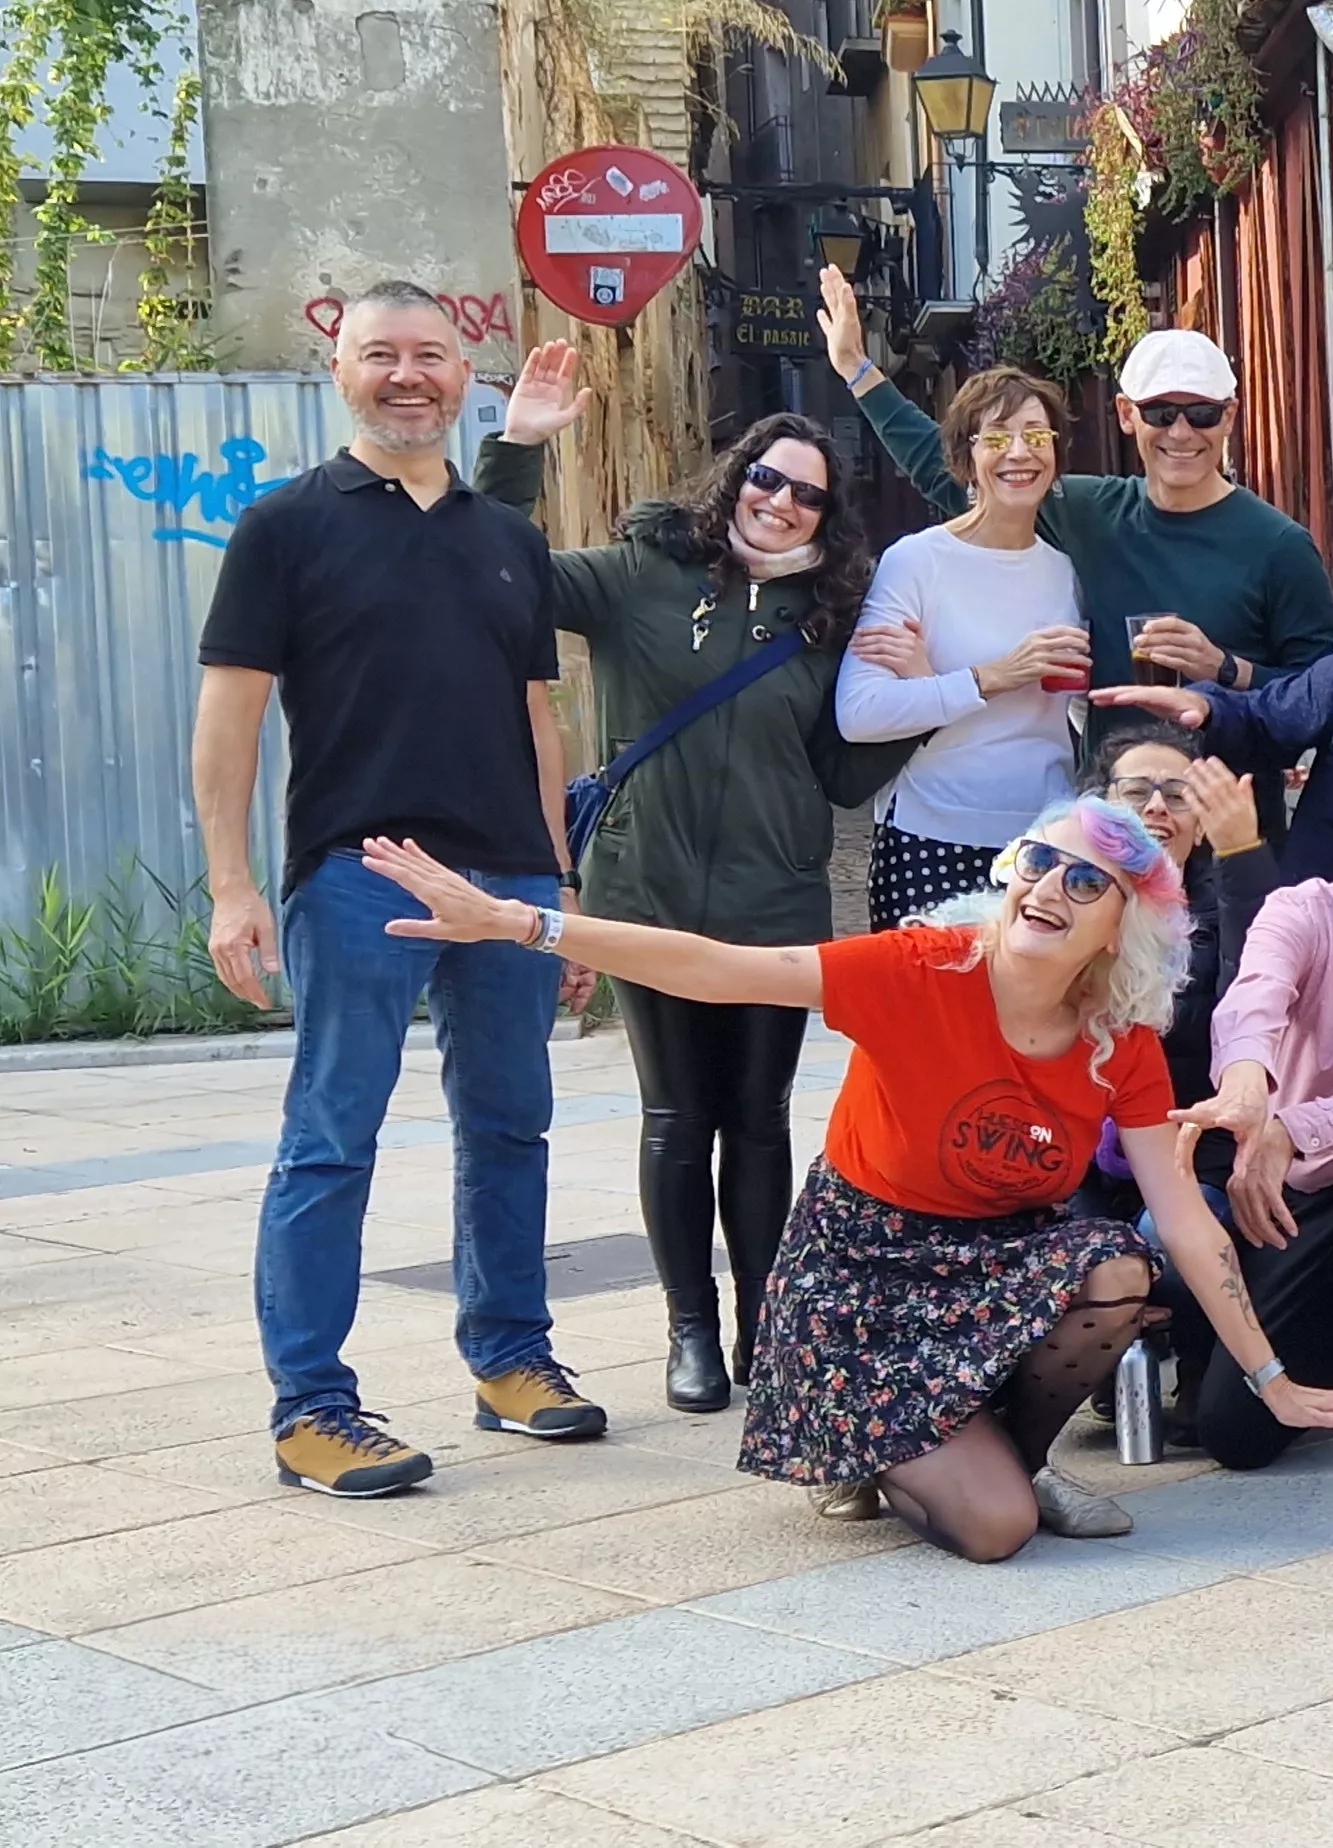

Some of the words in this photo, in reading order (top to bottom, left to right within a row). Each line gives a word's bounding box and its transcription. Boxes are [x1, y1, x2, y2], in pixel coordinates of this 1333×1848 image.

[740, 294, 805, 319] BAR
[736, 323, 754, 343] El
[763, 328, 811, 347] pasaje
[952, 1120, 1063, 1172] SWING
